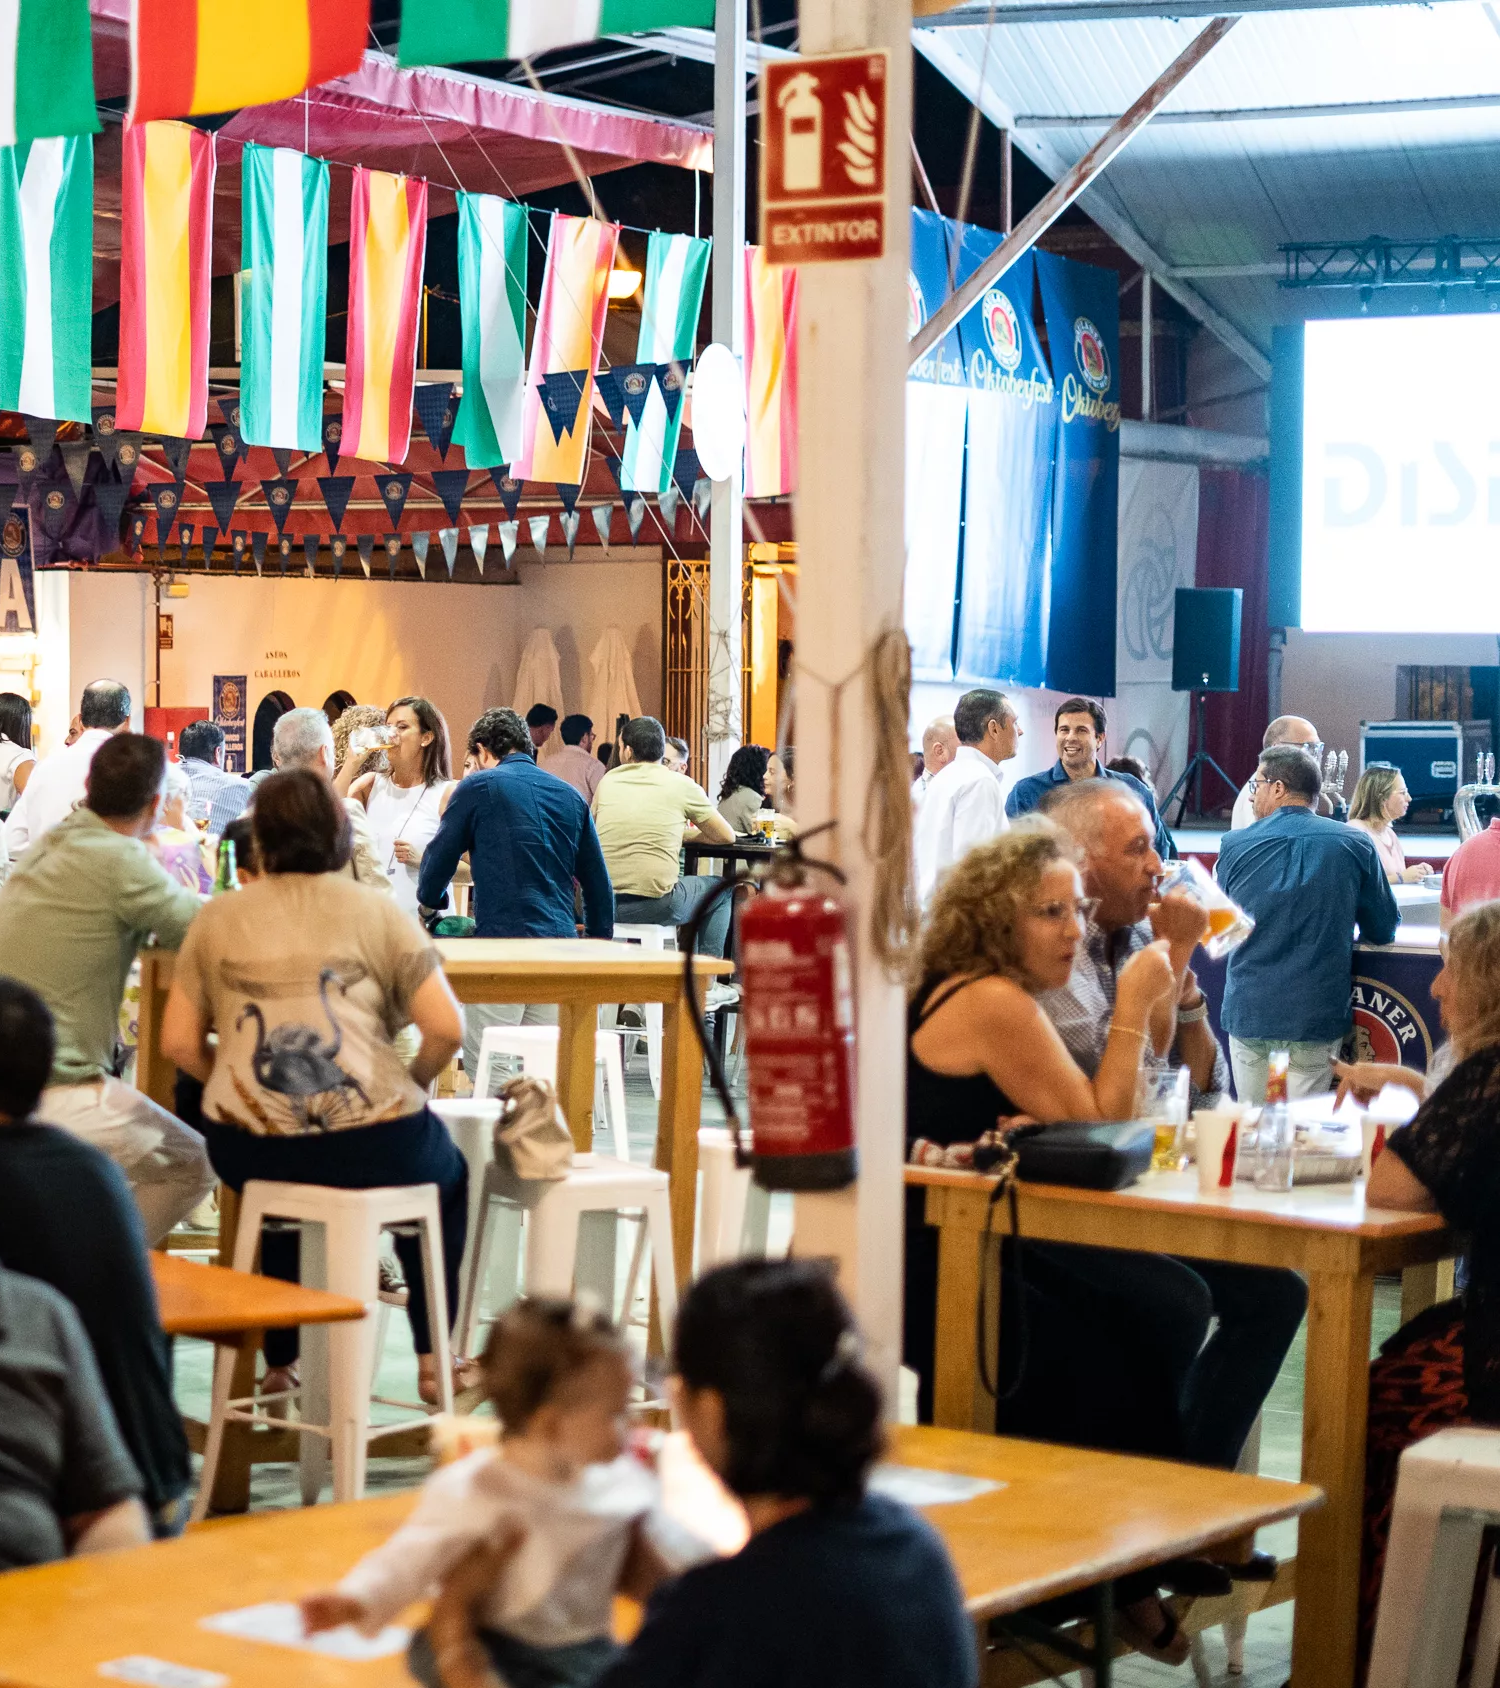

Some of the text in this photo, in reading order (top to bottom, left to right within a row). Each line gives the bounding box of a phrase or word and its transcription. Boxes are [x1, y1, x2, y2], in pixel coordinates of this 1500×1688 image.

[772, 218, 879, 246] EXTINTOR
[970, 348, 1054, 410] Oktoberfest
[254, 669, 301, 679] CABALLEROS
[1350, 986, 1418, 1045] ANER
